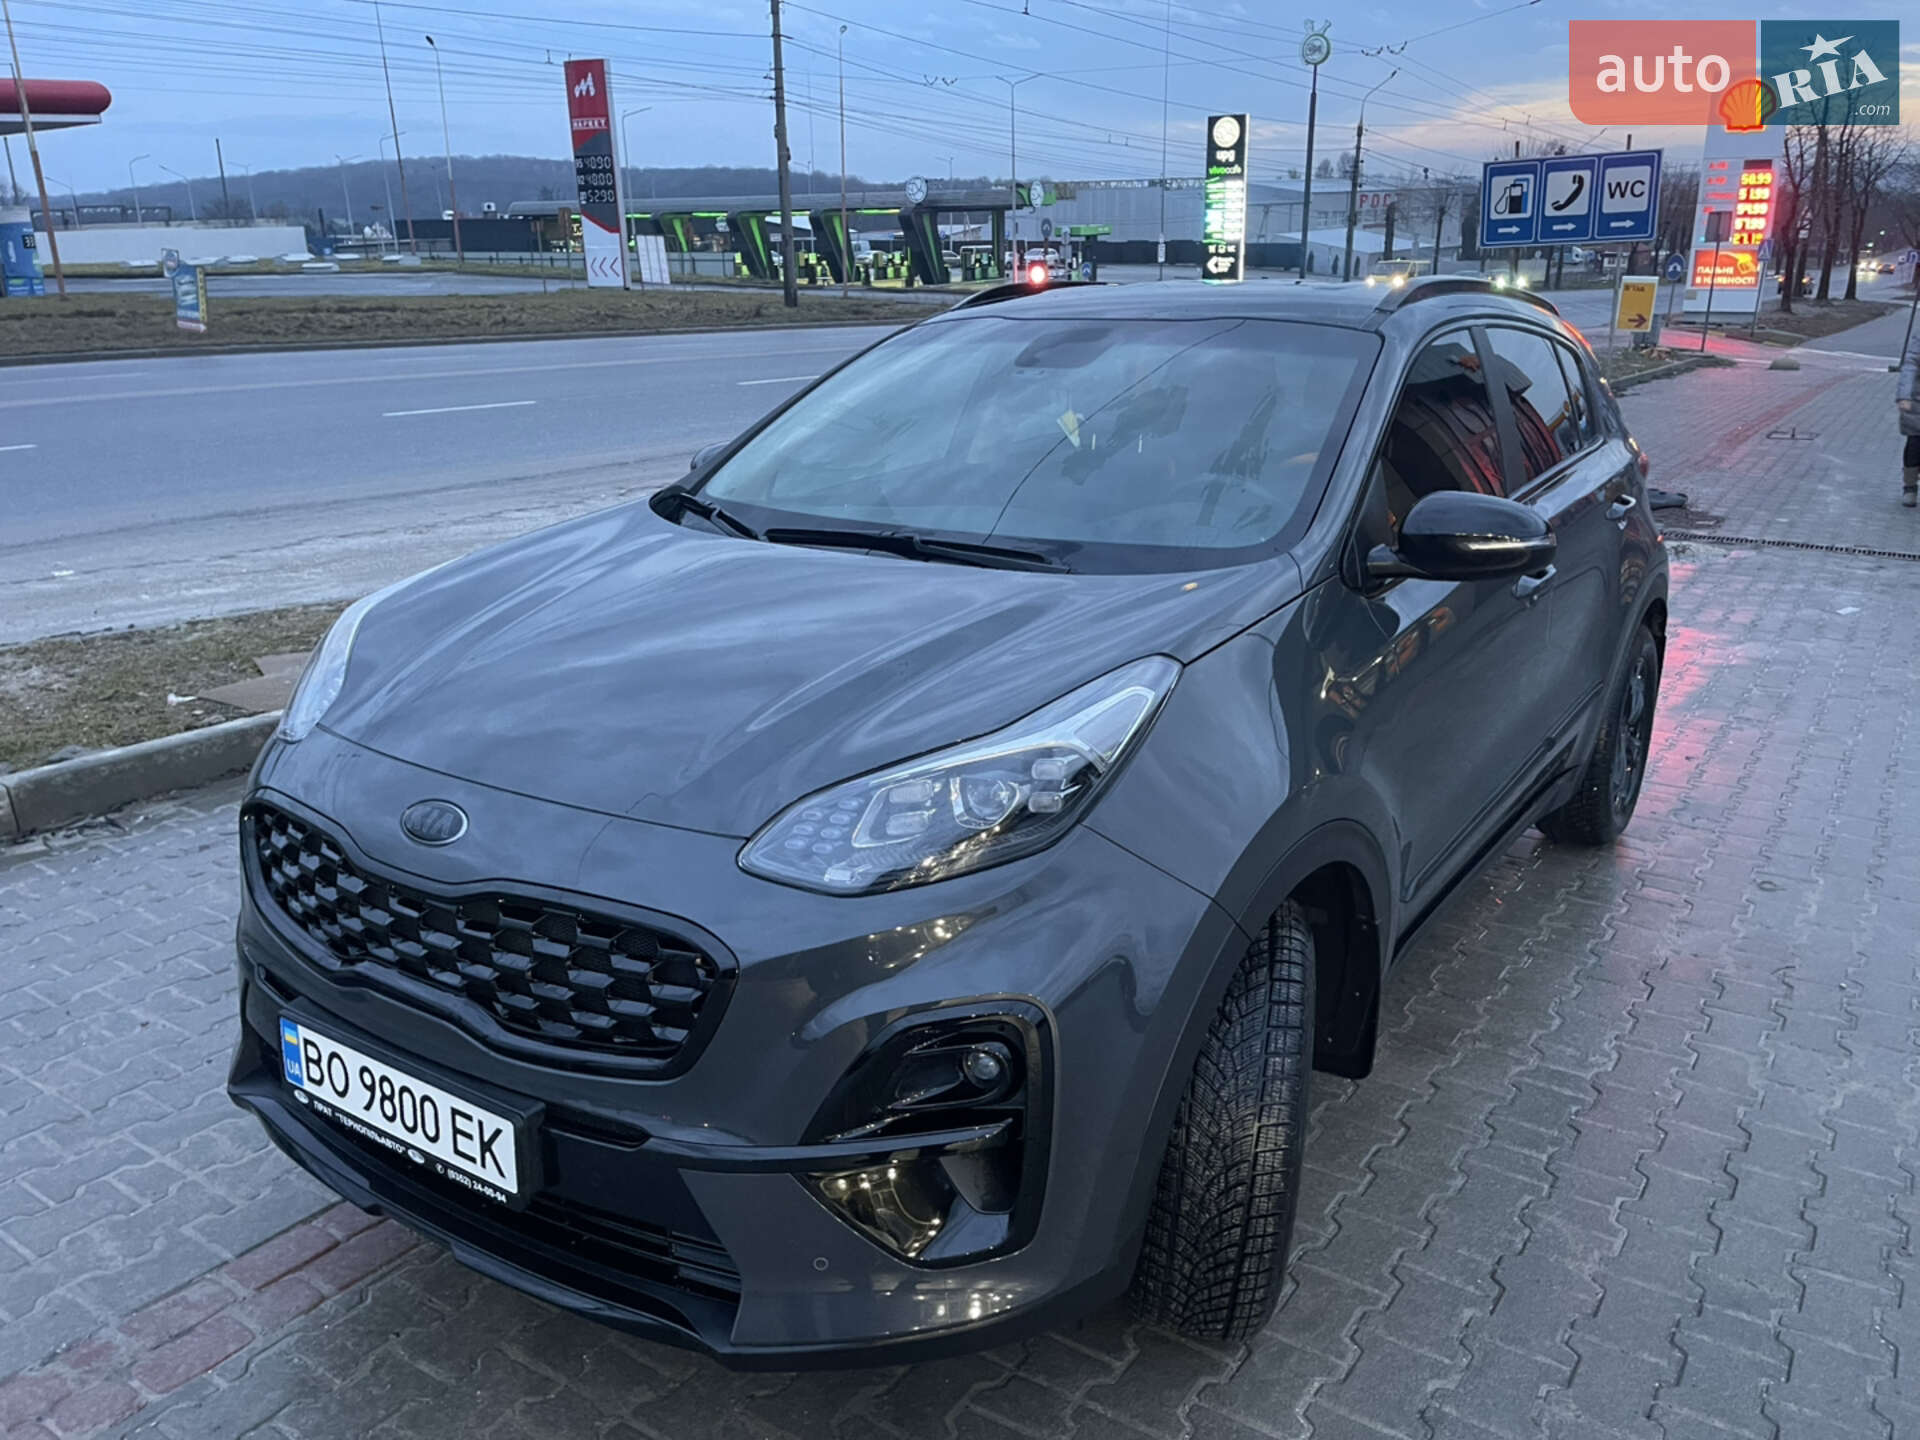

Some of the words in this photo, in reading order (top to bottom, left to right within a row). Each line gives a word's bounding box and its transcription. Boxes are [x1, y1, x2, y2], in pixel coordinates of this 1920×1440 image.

[1608, 180, 1646, 199] WC
[287, 1058, 302, 1078] UA
[303, 1038, 349, 1099] BO
[359, 1065, 440, 1144] 9800
[450, 1106, 507, 1180] EK
